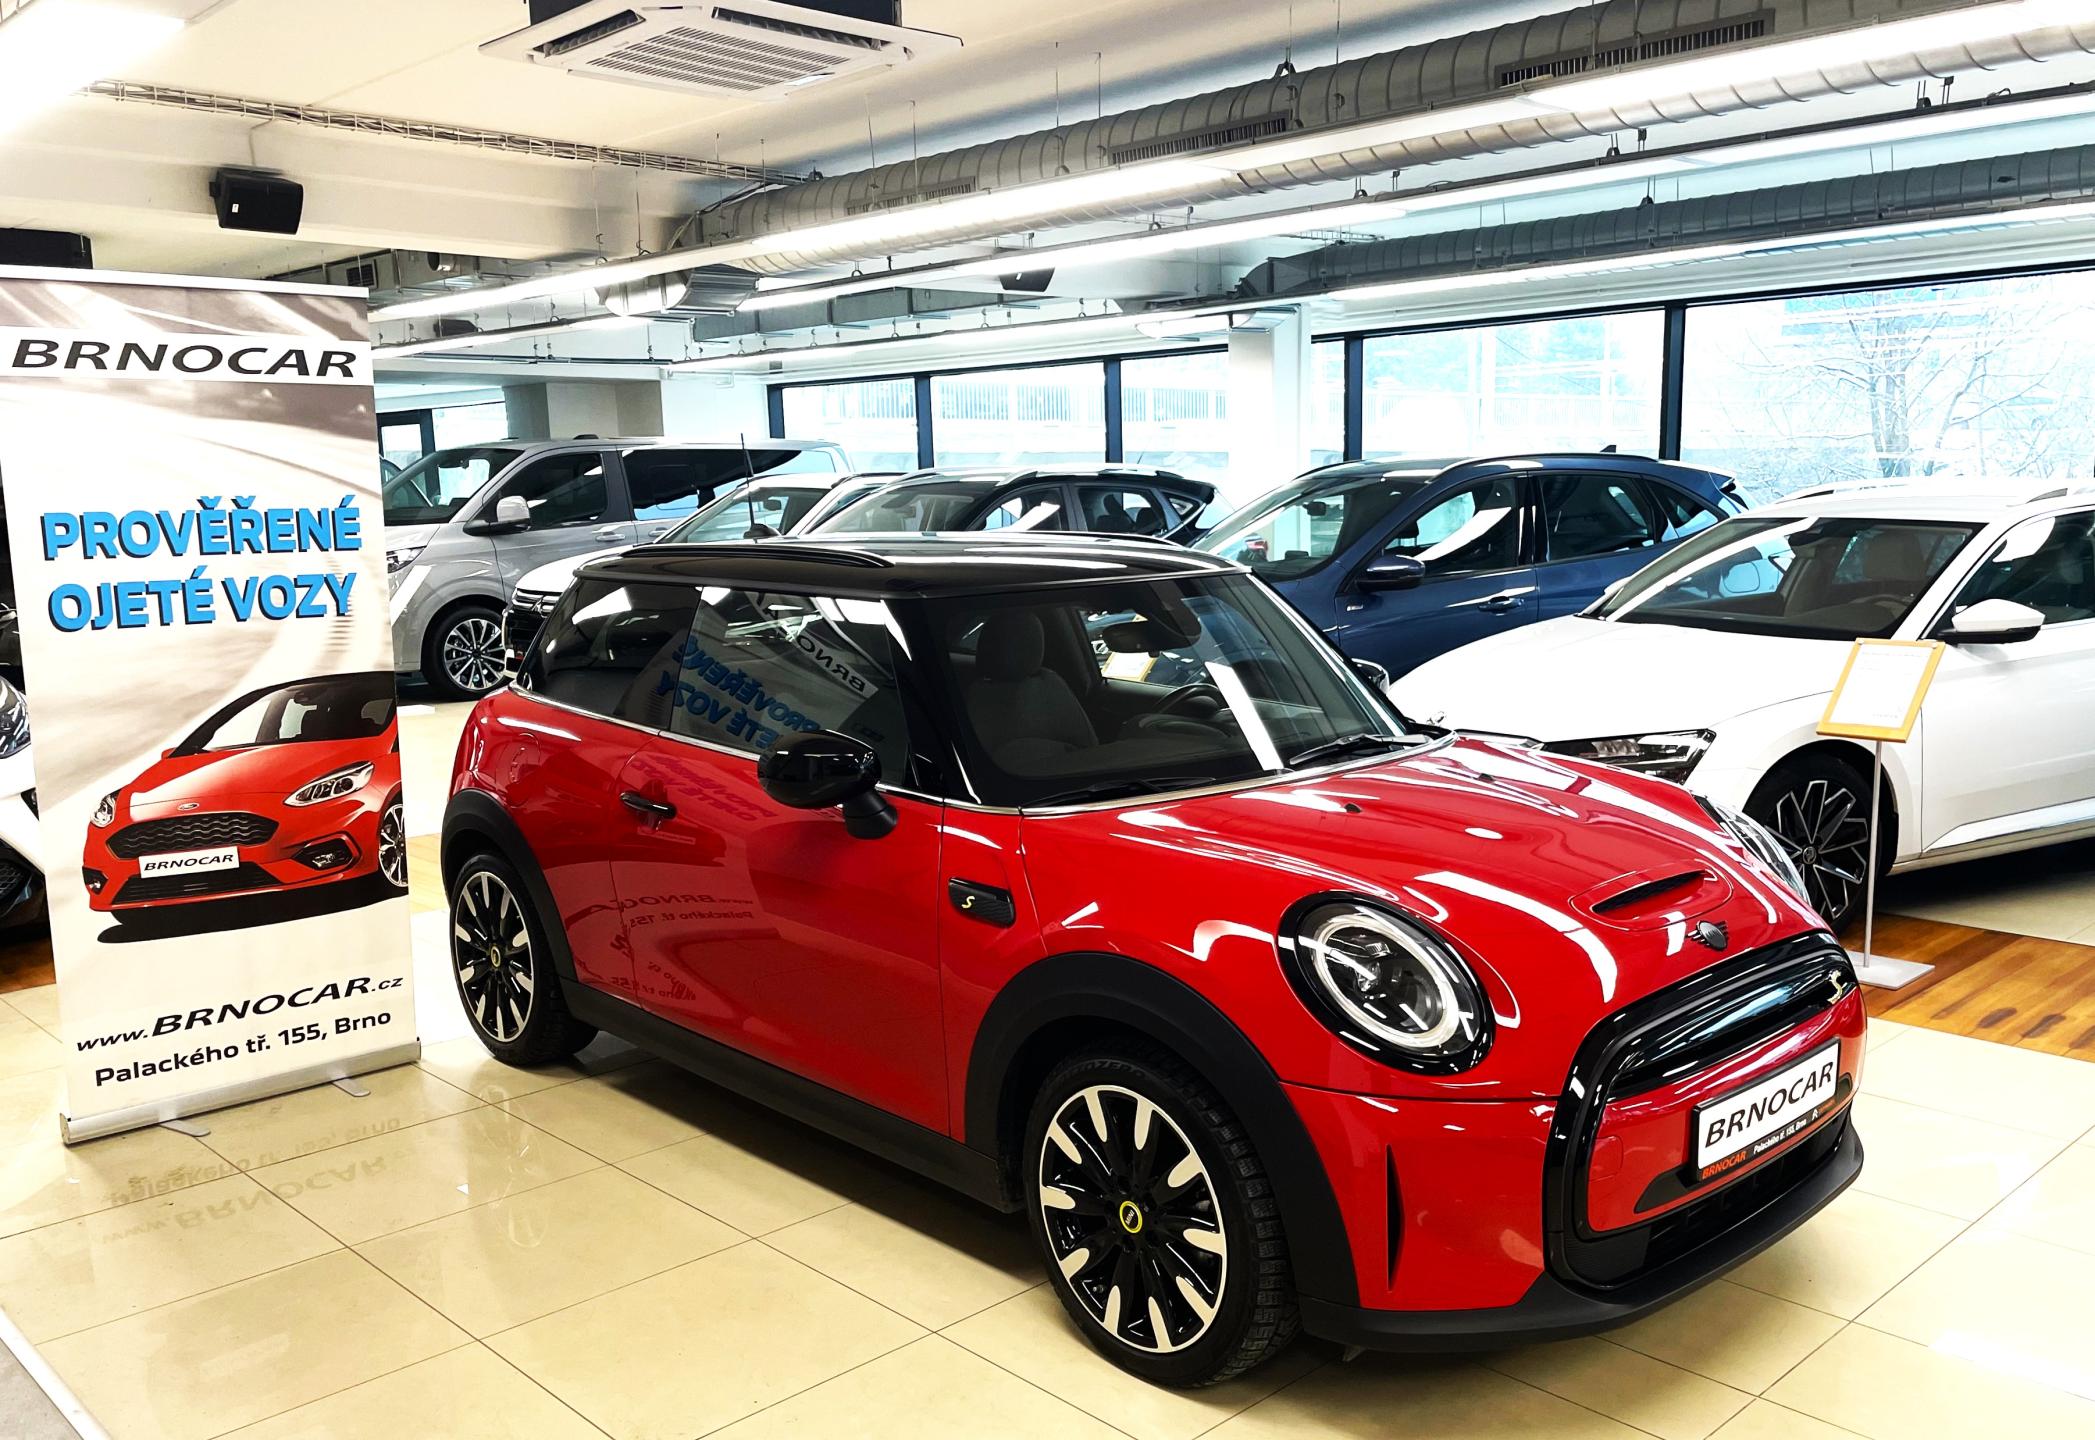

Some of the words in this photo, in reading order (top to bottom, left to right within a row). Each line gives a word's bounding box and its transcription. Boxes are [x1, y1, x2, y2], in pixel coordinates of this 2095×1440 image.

[11, 338, 357, 378] BRNOCAR
[40, 494, 363, 562] PROVĚŘENÉ
[48, 564, 217, 632] OJETÉ
[221, 571, 358, 621] VOZY
[143, 852, 235, 873] BRNOCAR
[961, 895, 976, 909] S
[75, 974, 405, 1053] www.BRNOCAR.cz
[95, 1043, 240, 1087] Palackého
[246, 1033, 272, 1054] tř.
[277, 1021, 328, 1046] 155,
[334, 1010, 392, 1036] Brno
[1705, 1061, 1834, 1149] BRNOCAR
[1701, 1150, 1748, 1180] BRNOCAR
